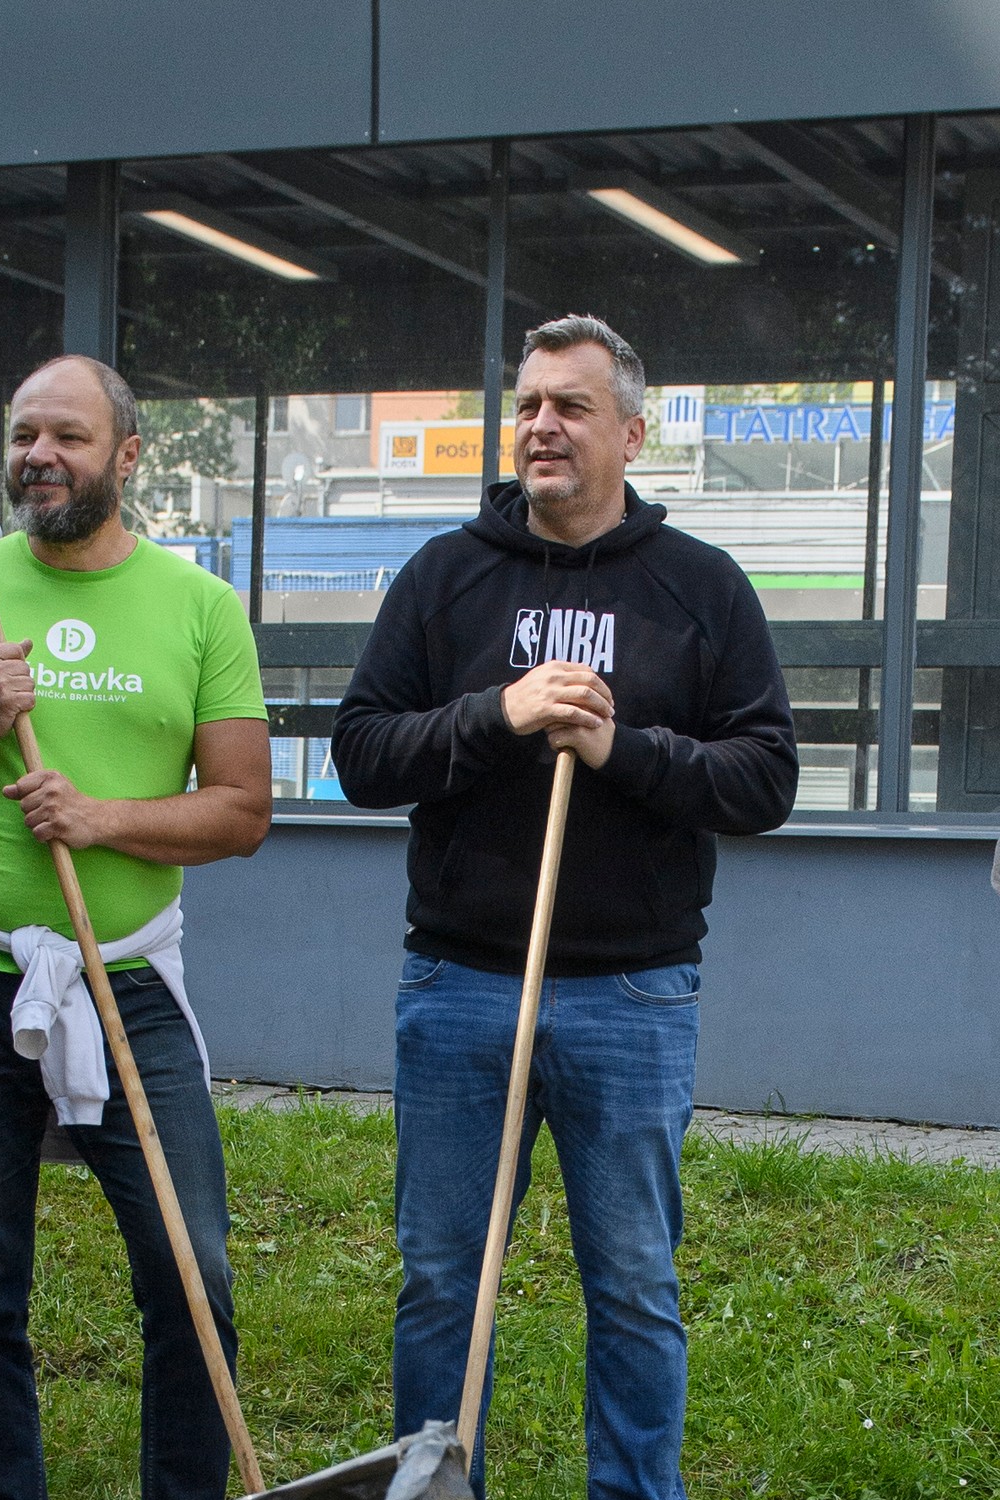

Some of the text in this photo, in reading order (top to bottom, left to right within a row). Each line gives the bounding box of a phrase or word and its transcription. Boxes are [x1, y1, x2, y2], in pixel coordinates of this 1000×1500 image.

[717, 405, 861, 443] TATRA
[435, 441, 484, 458] POŠT
[544, 607, 615, 673] NBA
[69, 692, 128, 703] BRATISLAVY
